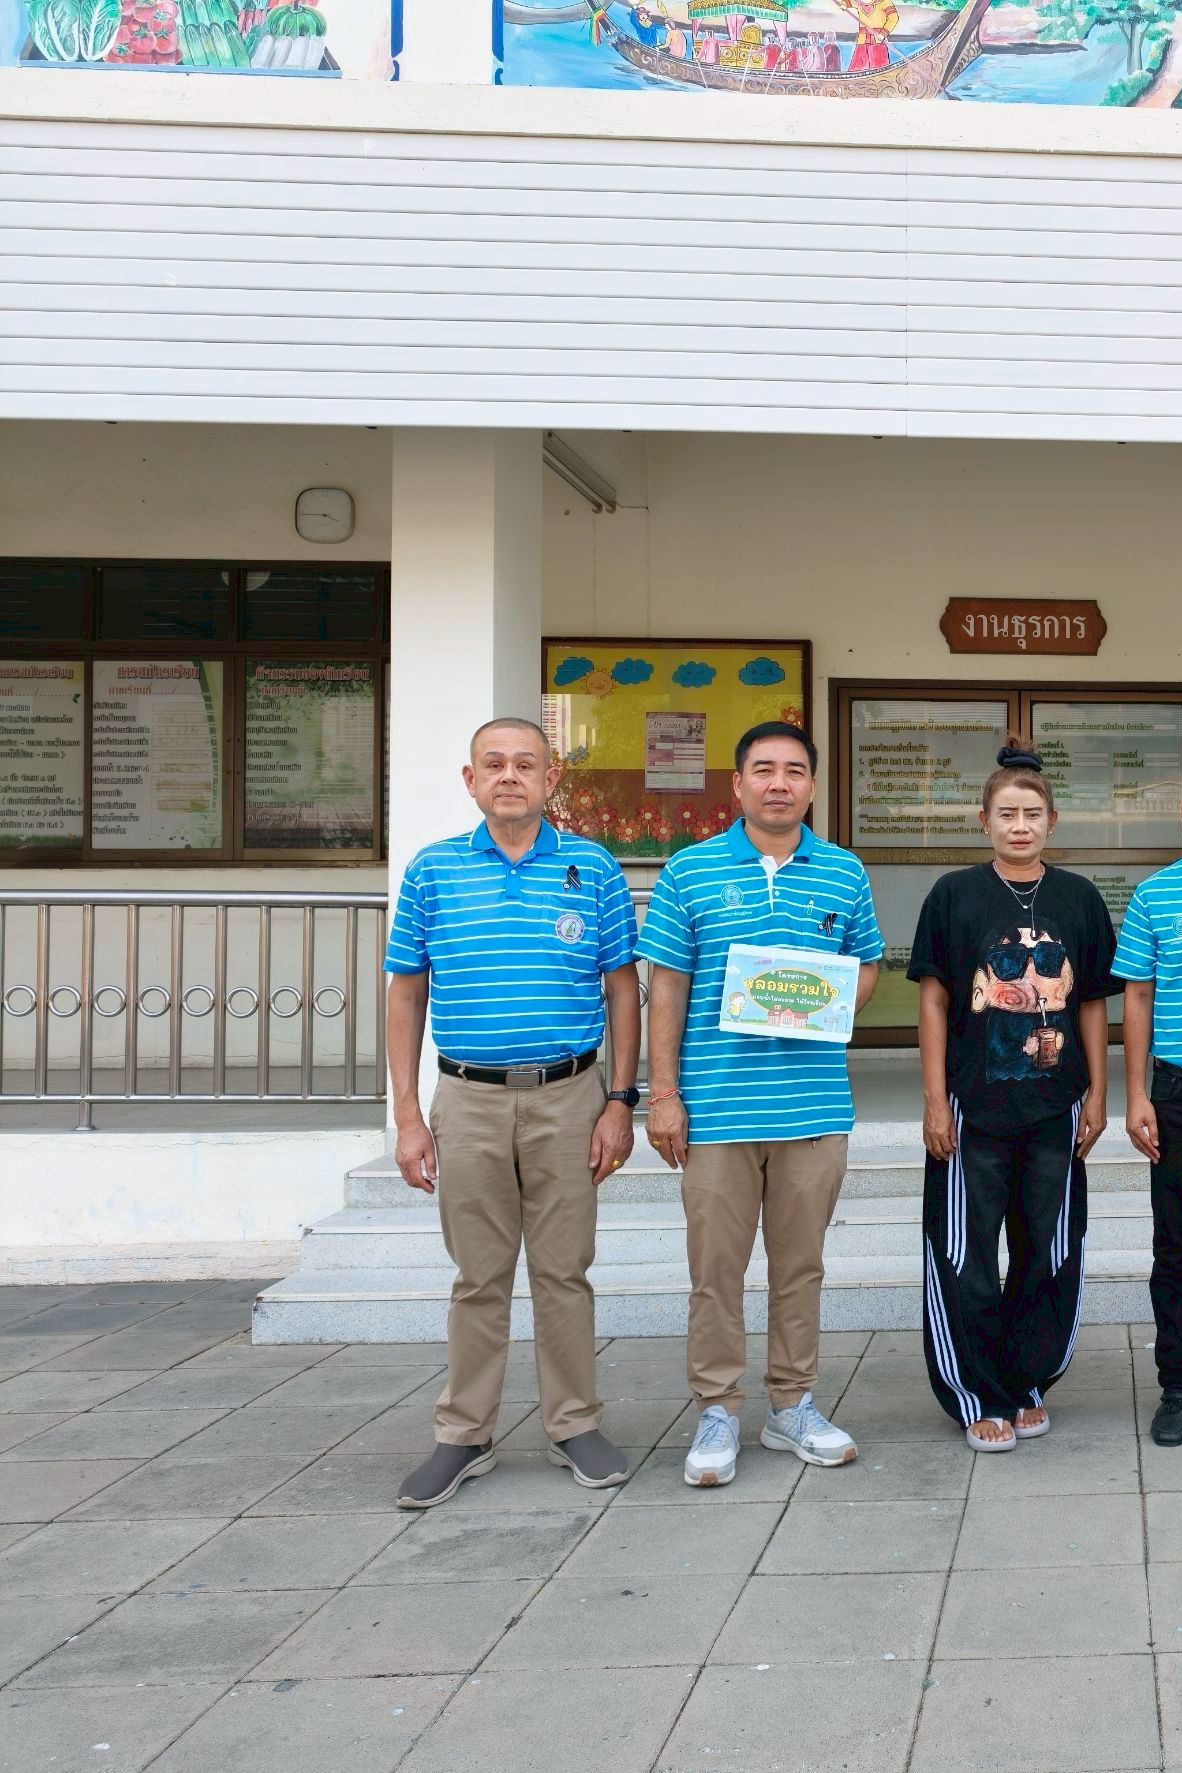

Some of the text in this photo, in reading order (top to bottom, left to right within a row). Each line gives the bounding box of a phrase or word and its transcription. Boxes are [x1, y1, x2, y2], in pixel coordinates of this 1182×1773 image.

[961, 613, 1087, 650] งานธุรการ
[743, 977, 841, 998] หลอมรวมใจ
